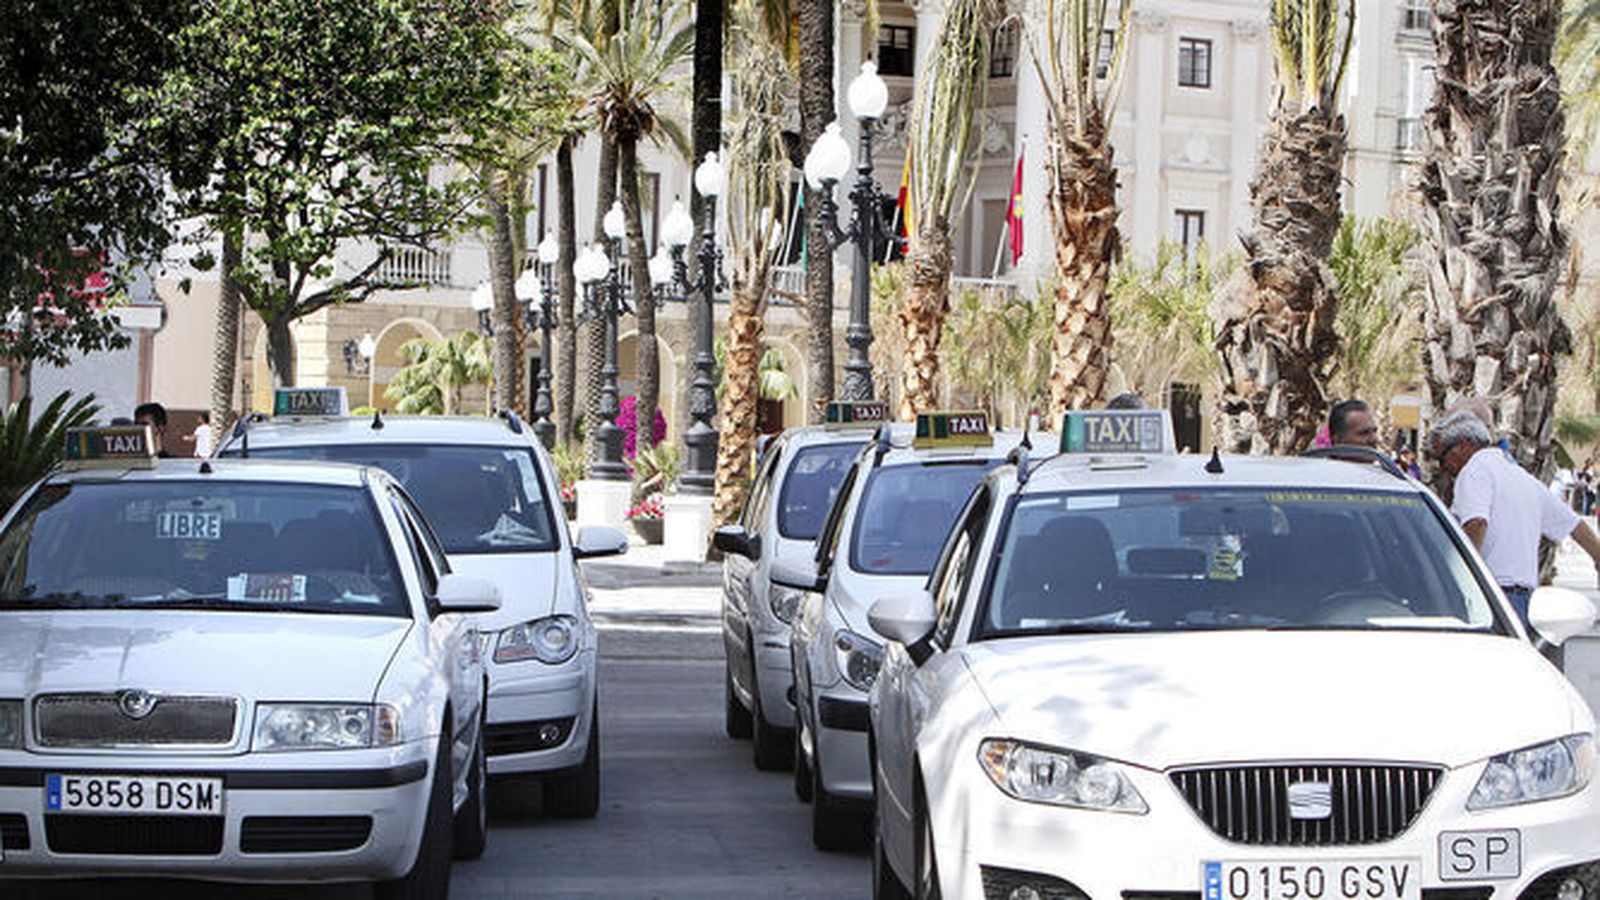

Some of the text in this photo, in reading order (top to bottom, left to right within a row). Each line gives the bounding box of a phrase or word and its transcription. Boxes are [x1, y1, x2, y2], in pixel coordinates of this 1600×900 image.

[290, 392, 325, 408] TAXI
[855, 406, 881, 418] TAXI
[951, 416, 985, 433] TAXI
[1084, 417, 1139, 442] TAXI
[104, 434, 142, 452] TAXI
[160, 513, 218, 537] LIBRE
[66, 779, 213, 810] 5858 DSM
[1451, 837, 1510, 872] SP
[1229, 864, 1409, 899] 0150 GSV
